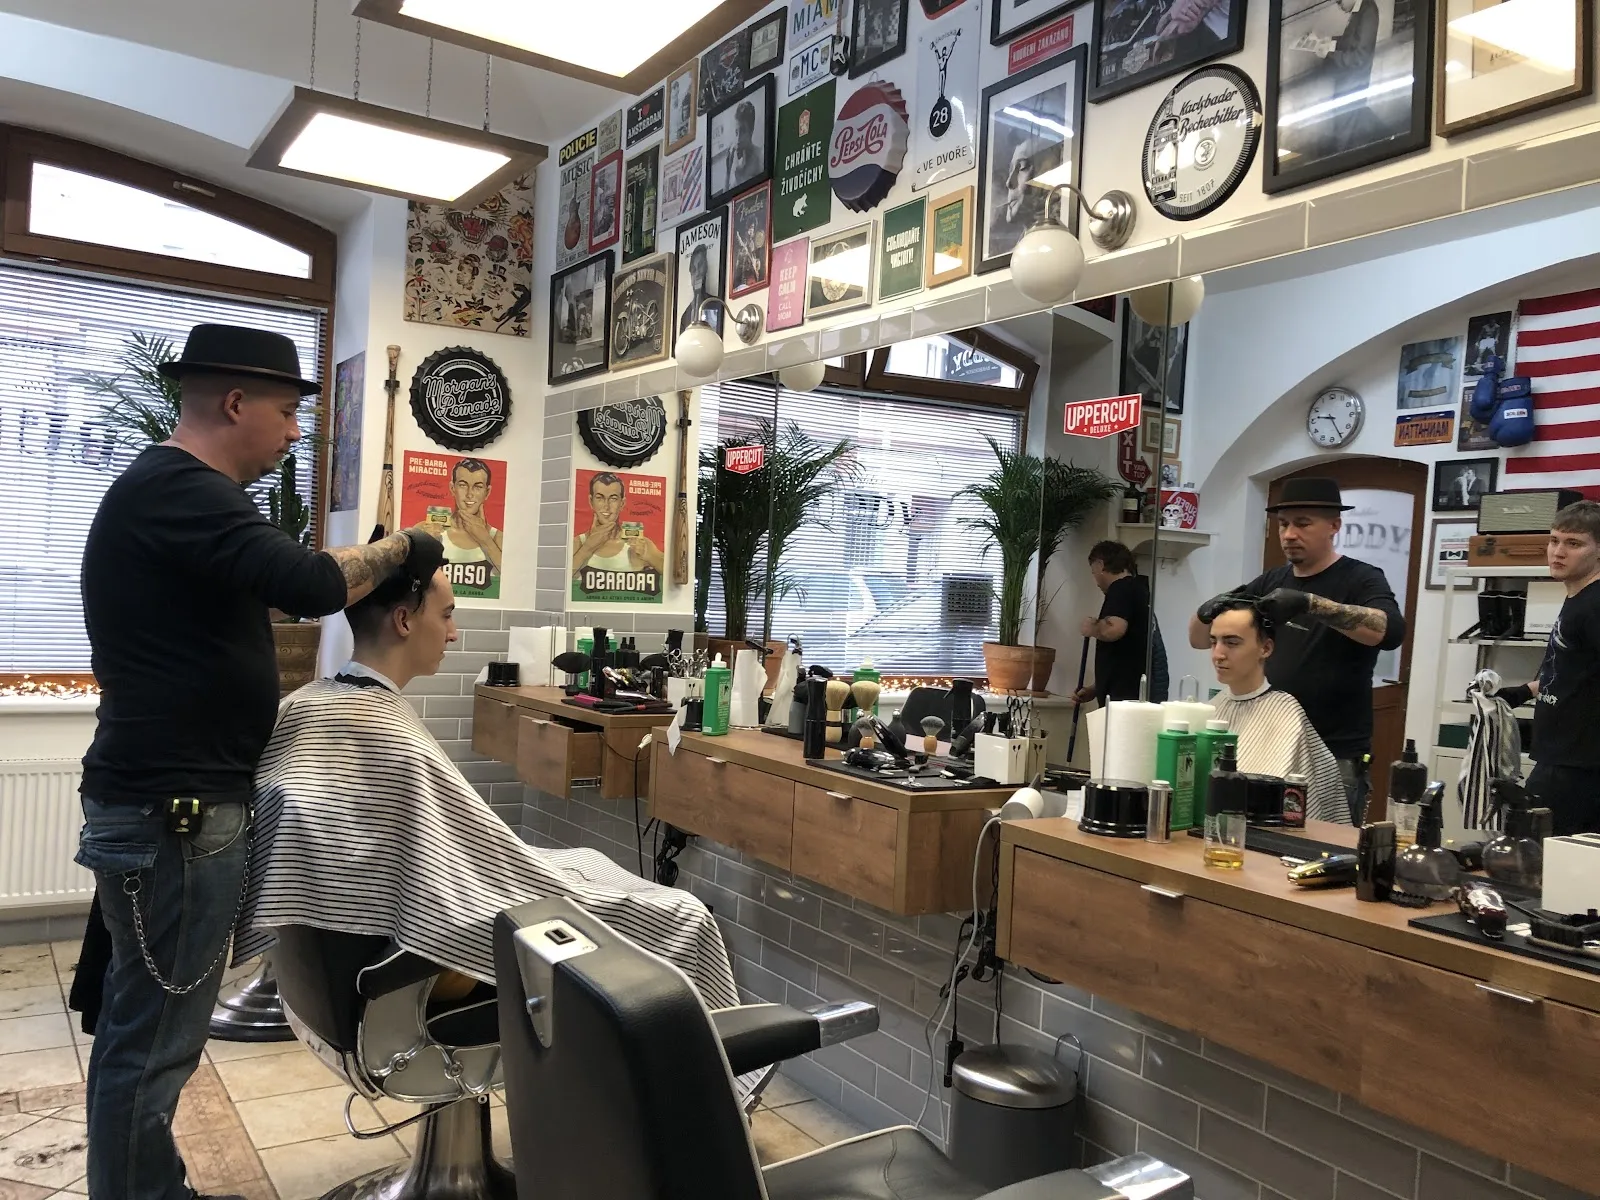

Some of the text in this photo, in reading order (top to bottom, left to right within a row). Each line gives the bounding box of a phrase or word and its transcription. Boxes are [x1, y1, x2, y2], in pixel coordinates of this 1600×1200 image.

[793, 0, 840, 35] MIAM
[801, 47, 820, 79] MC
[627, 110, 662, 137] AMSTERDAM
[932, 107, 949, 128] 28
[559, 131, 596, 163] POLICIE
[785, 140, 822, 171] CHRÁŇTE
[923, 145, 968, 171] VE DVOŘE
[561, 156, 593, 187] MUSIC
[781, 164, 824, 196] ŽIVOČÍCHY
[1179, 178, 1215, 203] SEIT 1807
[680, 222, 721, 255] JAMESON
[780, 265, 798, 281] KEEP
[778, 280, 796, 297] CALM
[778, 301, 792, 311] CALL
[422, 373, 497, 409] Morgan's
[434, 393, 500, 419] Pomade
[1067, 399, 1138, 431] UPPERCUT
[1089, 424, 1111, 434] DELUXE
[408, 465, 448, 477] MIRACOLO
[409, 457, 448, 469] PRE-BARBA
[727, 448, 762, 468] UPPERCUT
[443, 563, 486, 585] RASO
